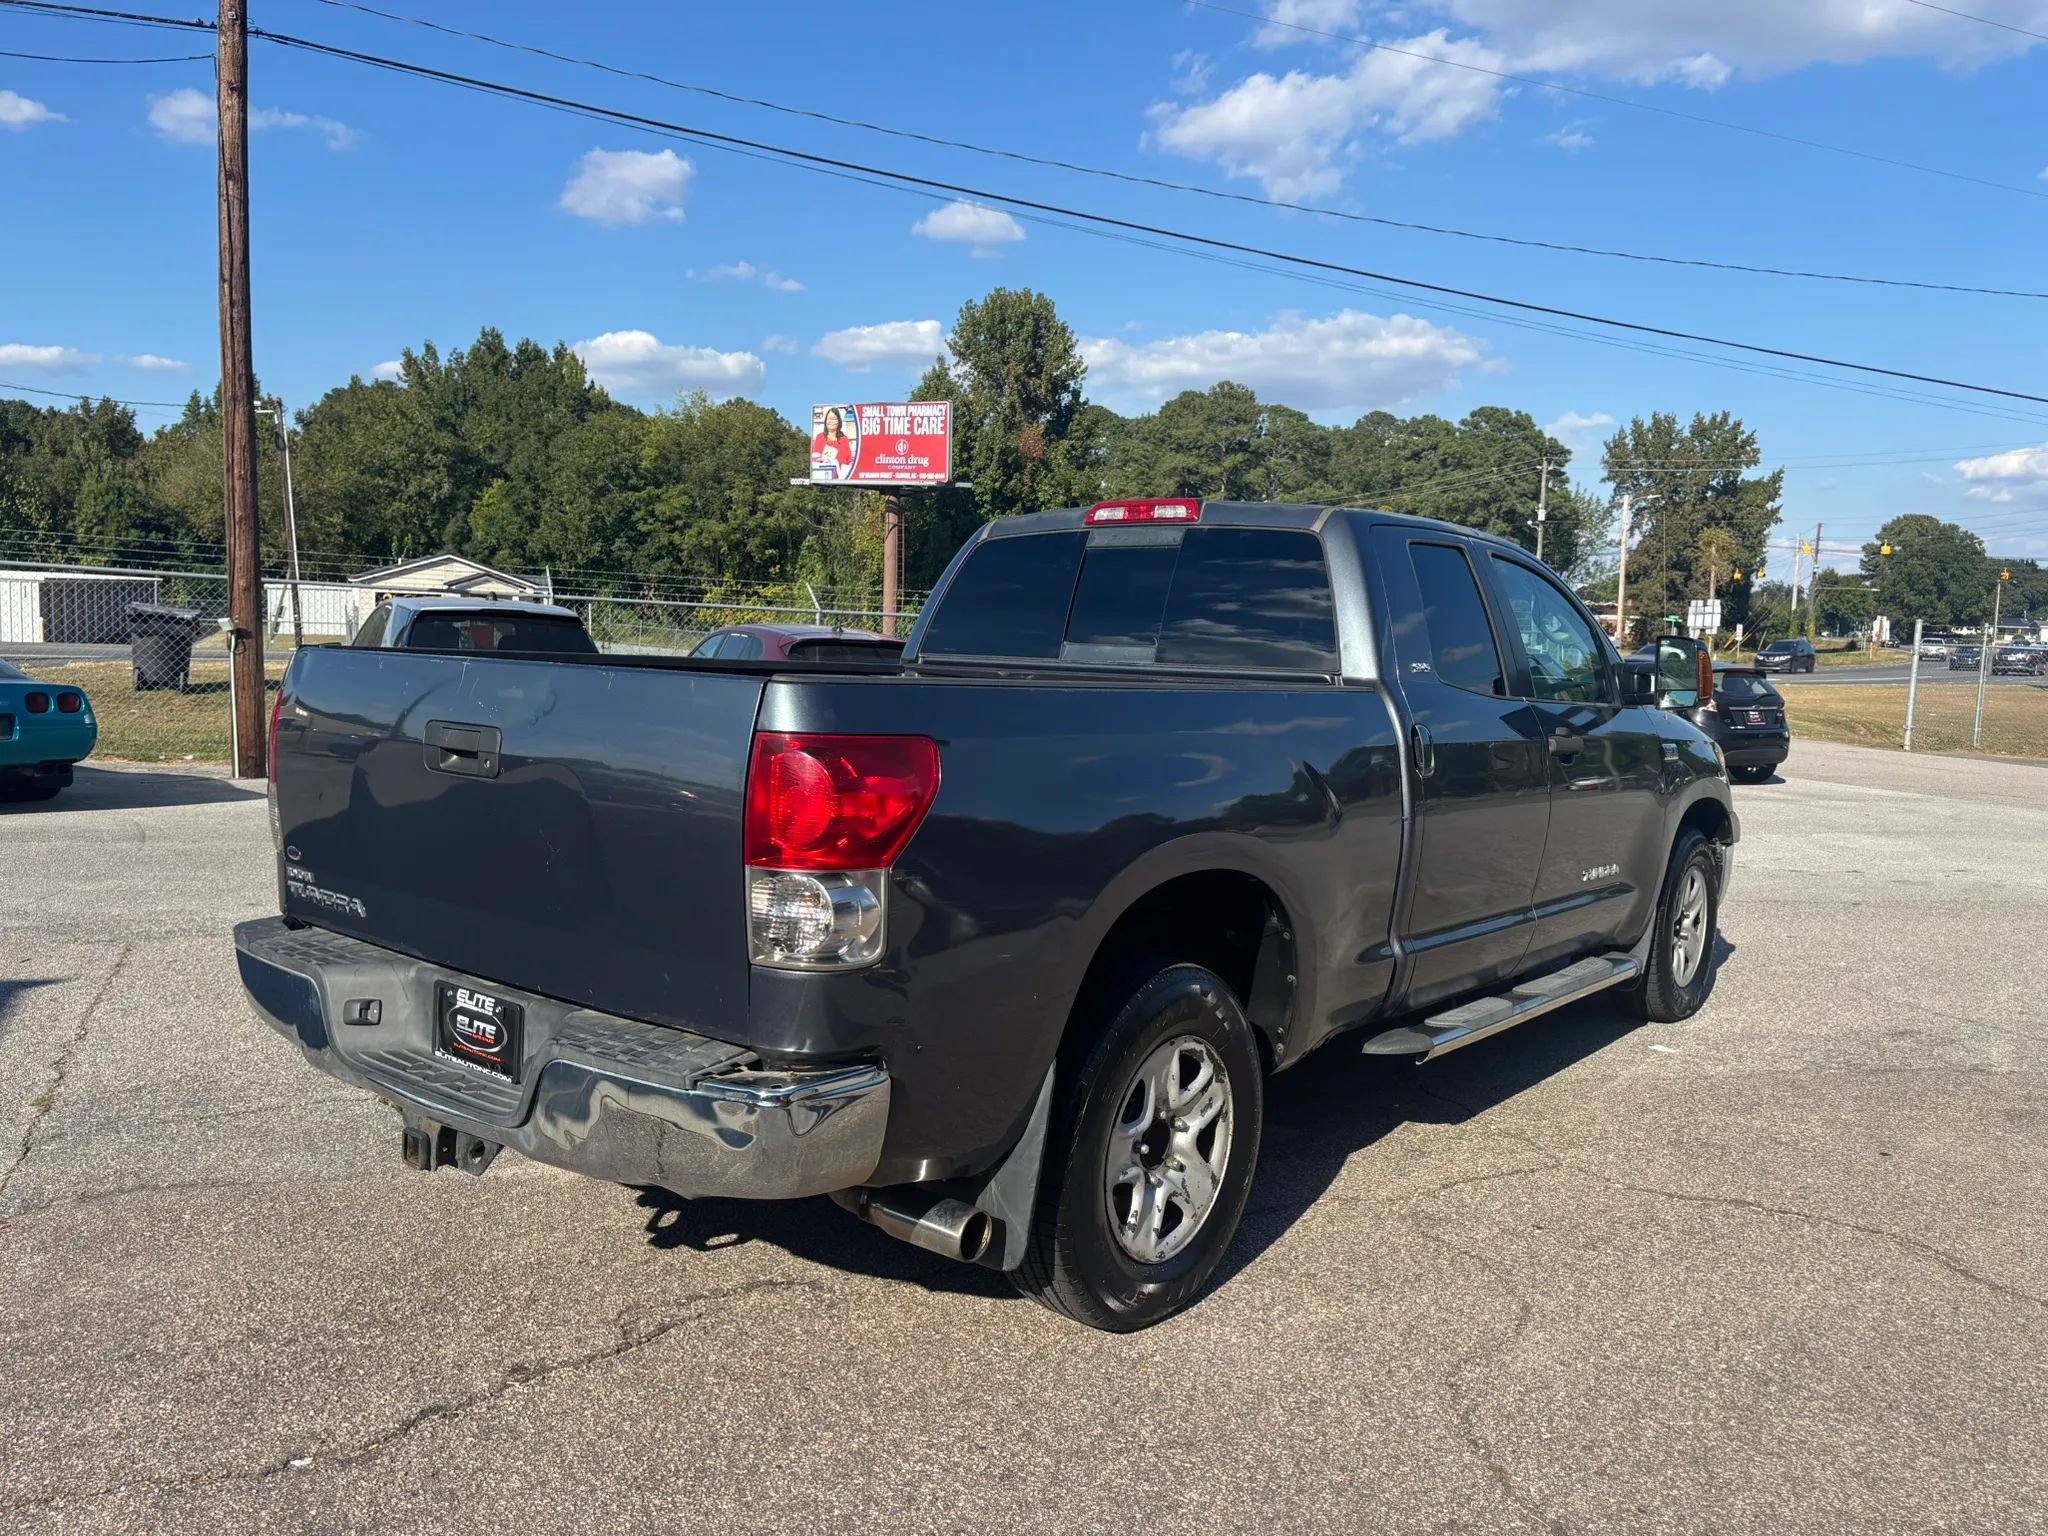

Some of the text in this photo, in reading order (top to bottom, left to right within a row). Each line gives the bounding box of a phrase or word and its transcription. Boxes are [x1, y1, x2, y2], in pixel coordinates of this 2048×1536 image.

[862, 404, 946, 418] SMALL TOWN PHARMACY
[862, 416, 945, 436] BIG TIME CARE
[875, 453, 930, 467] clinton drug
[456, 988, 496, 1012] ELITE
[456, 1014, 497, 1039] ELITE
